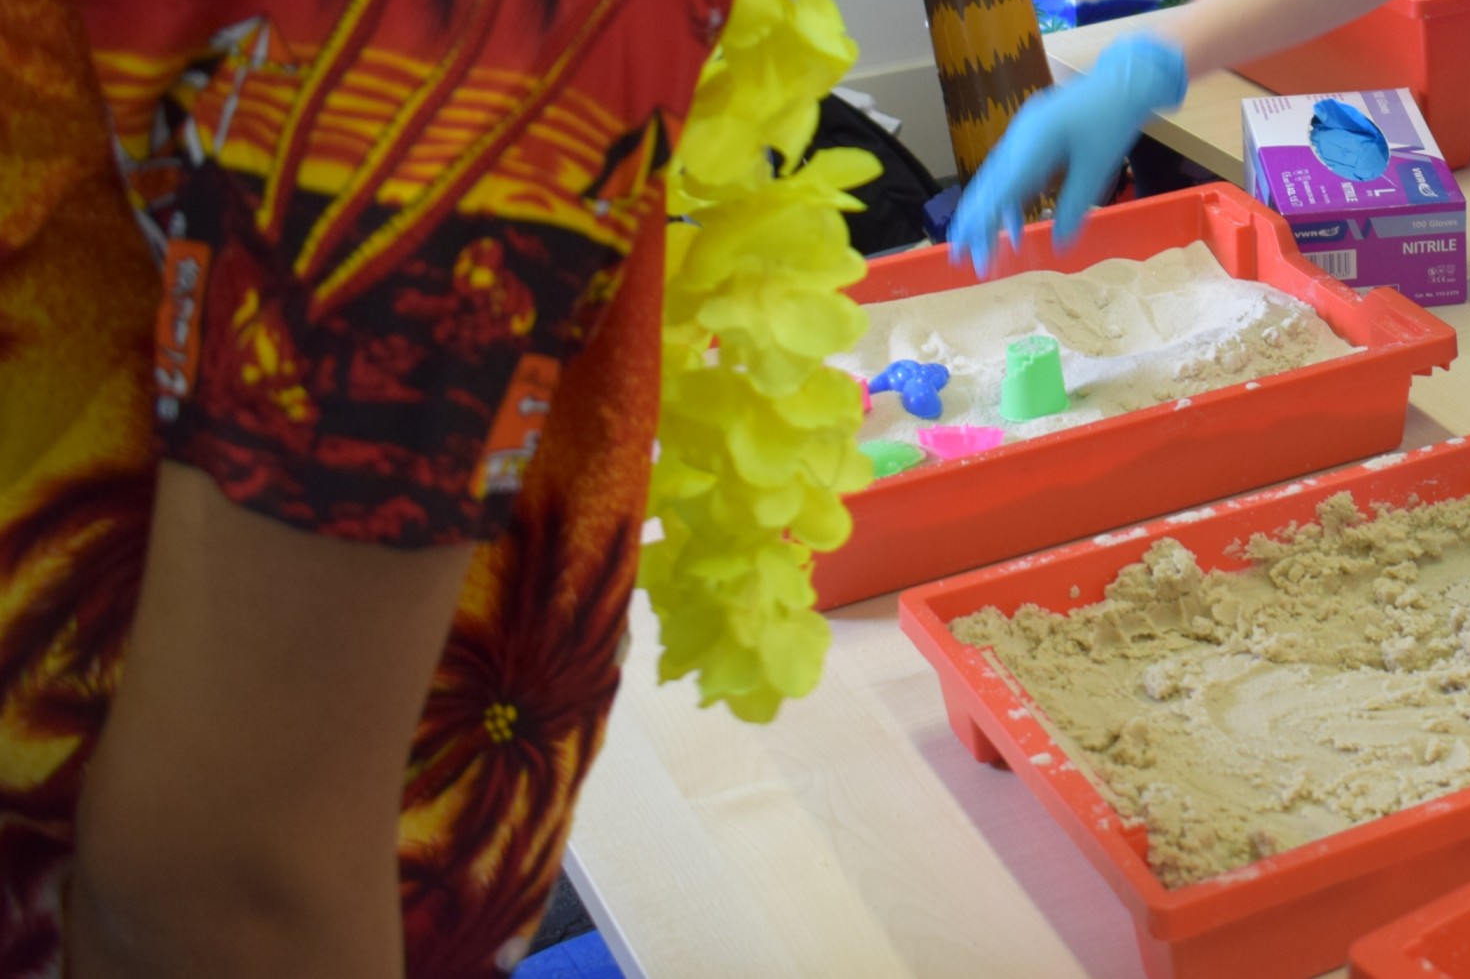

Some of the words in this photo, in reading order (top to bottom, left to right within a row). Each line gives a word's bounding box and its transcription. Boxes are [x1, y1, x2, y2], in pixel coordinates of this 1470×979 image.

[1412, 167, 1427, 183] VWR
[1340, 182, 1359, 202] NITRILE
[1373, 188, 1396, 197] L
[1412, 220, 1427, 228] 100
[1429, 219, 1458, 228] Gloves
[1294, 229, 1318, 239] VWR
[1402, 238, 1457, 255] NITRILE
